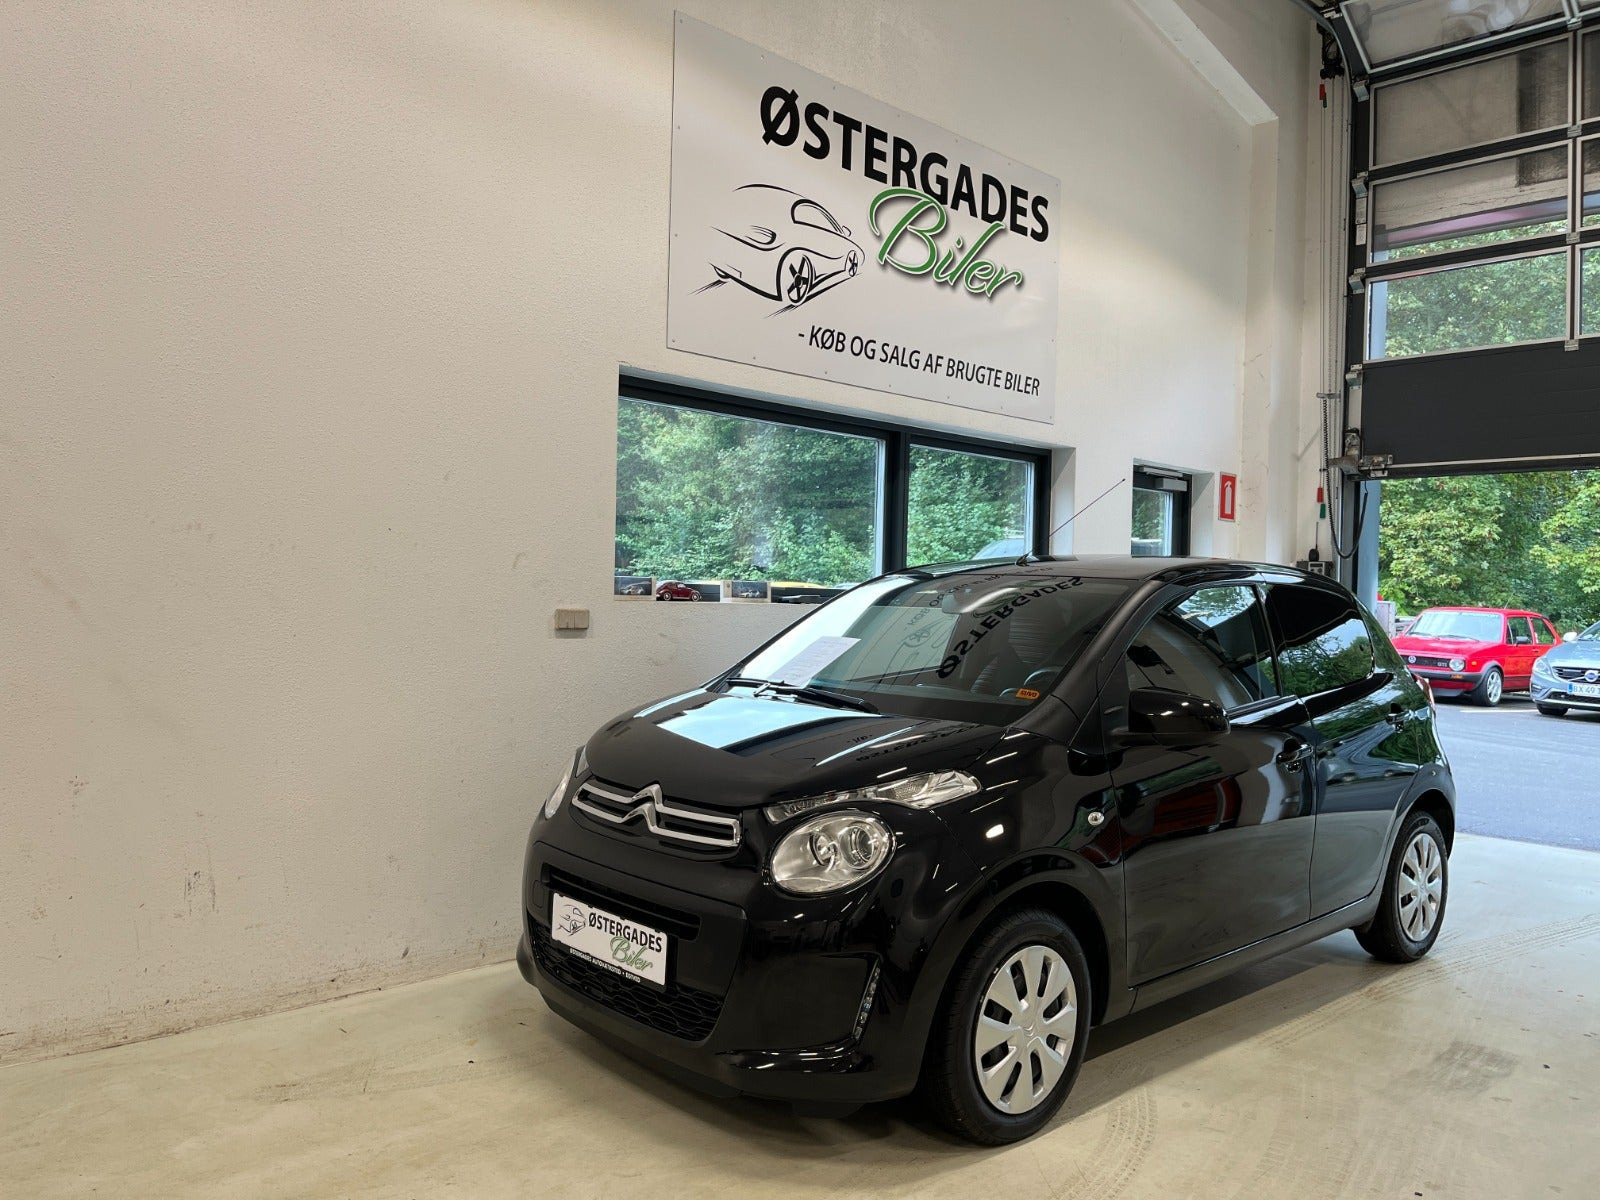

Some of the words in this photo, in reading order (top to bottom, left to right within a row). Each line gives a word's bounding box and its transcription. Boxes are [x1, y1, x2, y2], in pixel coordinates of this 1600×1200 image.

[760, 86, 1049, 242] ØSTERGADES
[868, 187, 1023, 297] Biler
[809, 325, 846, 353] KØB
[850, 336, 876, 359] OG
[880, 343, 920, 369] SALG
[923, 353, 944, 374] AF
[946, 358, 1003, 388] BRUGTE
[1004, 371, 1040, 396] BILER
[588, 912, 662, 953] ØSTERGADES
[610, 936, 653, 972] Biler
